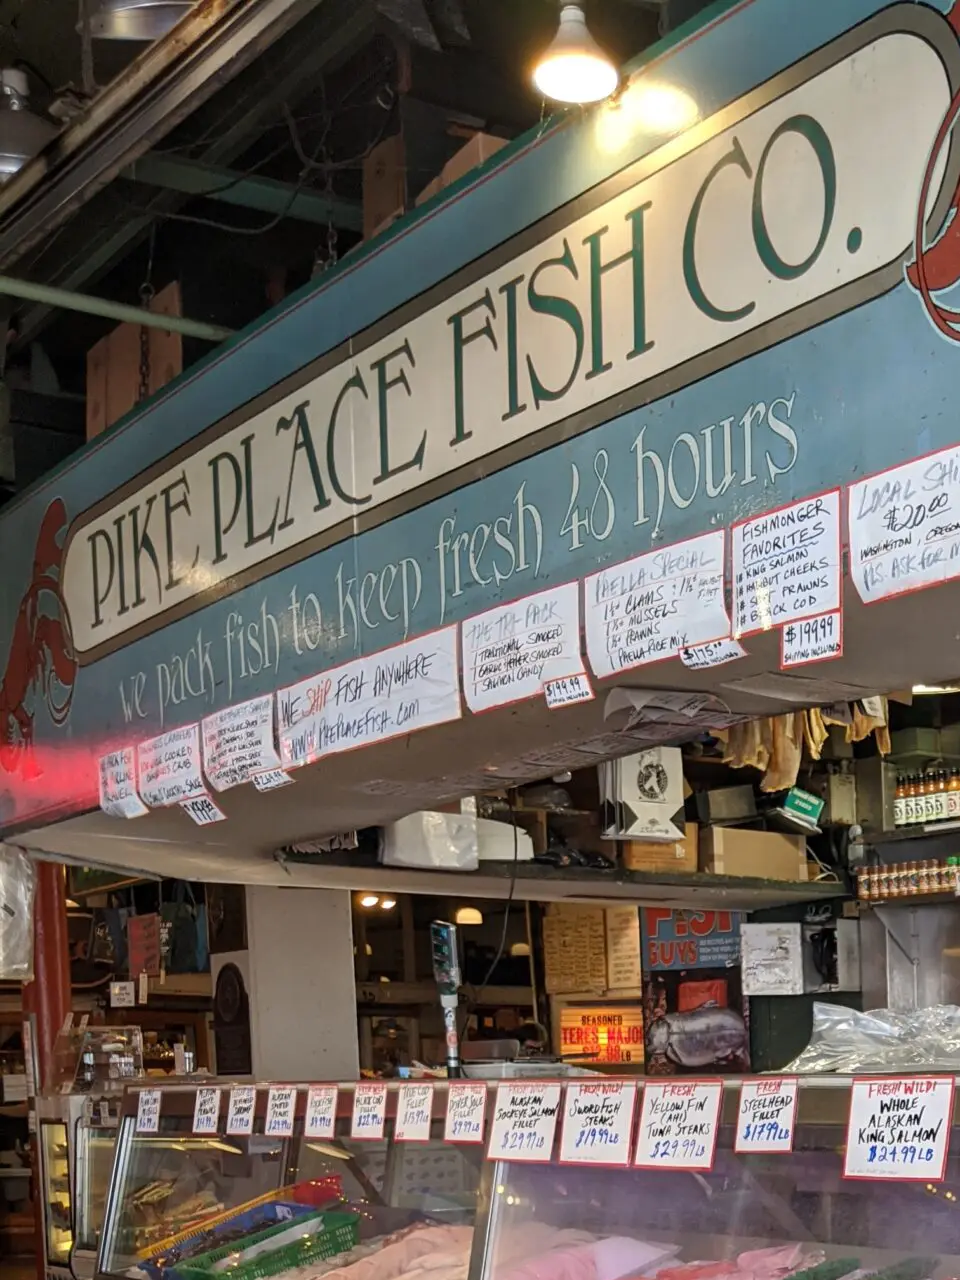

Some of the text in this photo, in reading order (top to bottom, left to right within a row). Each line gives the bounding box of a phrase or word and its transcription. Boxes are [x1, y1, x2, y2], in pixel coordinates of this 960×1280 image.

[88, 114, 862, 630] PIKE PLACE FISH CO.
[857, 479, 916, 520] LOCAL
[742, 499, 830, 543] FISHMONGER
[881, 493, 950, 532] $20.00
[743, 521, 825, 565] FAVORITES
[119, 393, 799, 728] we pack fish to keep fresh 48 hours
[746, 548, 808, 580] KING SALMON
[784, 556, 829, 580] CHEEKS
[892, 552, 918, 578] ASK
[782, 575, 829, 596] PRAWNS
[625, 585, 664, 614] CLAMS
[794, 595, 816, 610] COD
[525, 601, 562, 628] PACK
[628, 600, 678, 626] MUSSELS
[526, 624, 562, 644] SMOKED
[626, 621, 660, 646] PRAWNS
[529, 643, 562, 662] SMOKED
[281, 692, 301, 728] WE
[334, 670, 369, 706] FISH
[373, 652, 437, 698] ANYWHERE
[648, 940, 697, 967] GUYS
[581, 1015, 622, 1026] SEASONED
[662, 1083, 697, 1098] FRESH!
[756, 1080, 783, 1095] FRESH
[868, 1080, 937, 1098] FRESH! WILD!
[510, 1095, 544, 1106] ALASKAN
[650, 1096, 708, 1115] YELLOW FIN
[741, 1095, 792, 1114] STEELHEAD
[880, 1097, 919, 1114] WHOLE
[512, 1118, 540, 1130] FILLET
[581, 1115, 614, 1128] STEAKS
[660, 1109, 688, 1125] (AHI)
[752, 1107, 784, 1122] FILLET
[868, 1105, 926, 1128] ALASKAN
[646, 1121, 711, 1139] TUNA STEAKS
[743, 1121, 779, 1141] $17.99
[858, 1118, 943, 1145] KING SALMON
[650, 1139, 696, 1158] $29.99
[867, 1145, 916, 1164] $24.99
